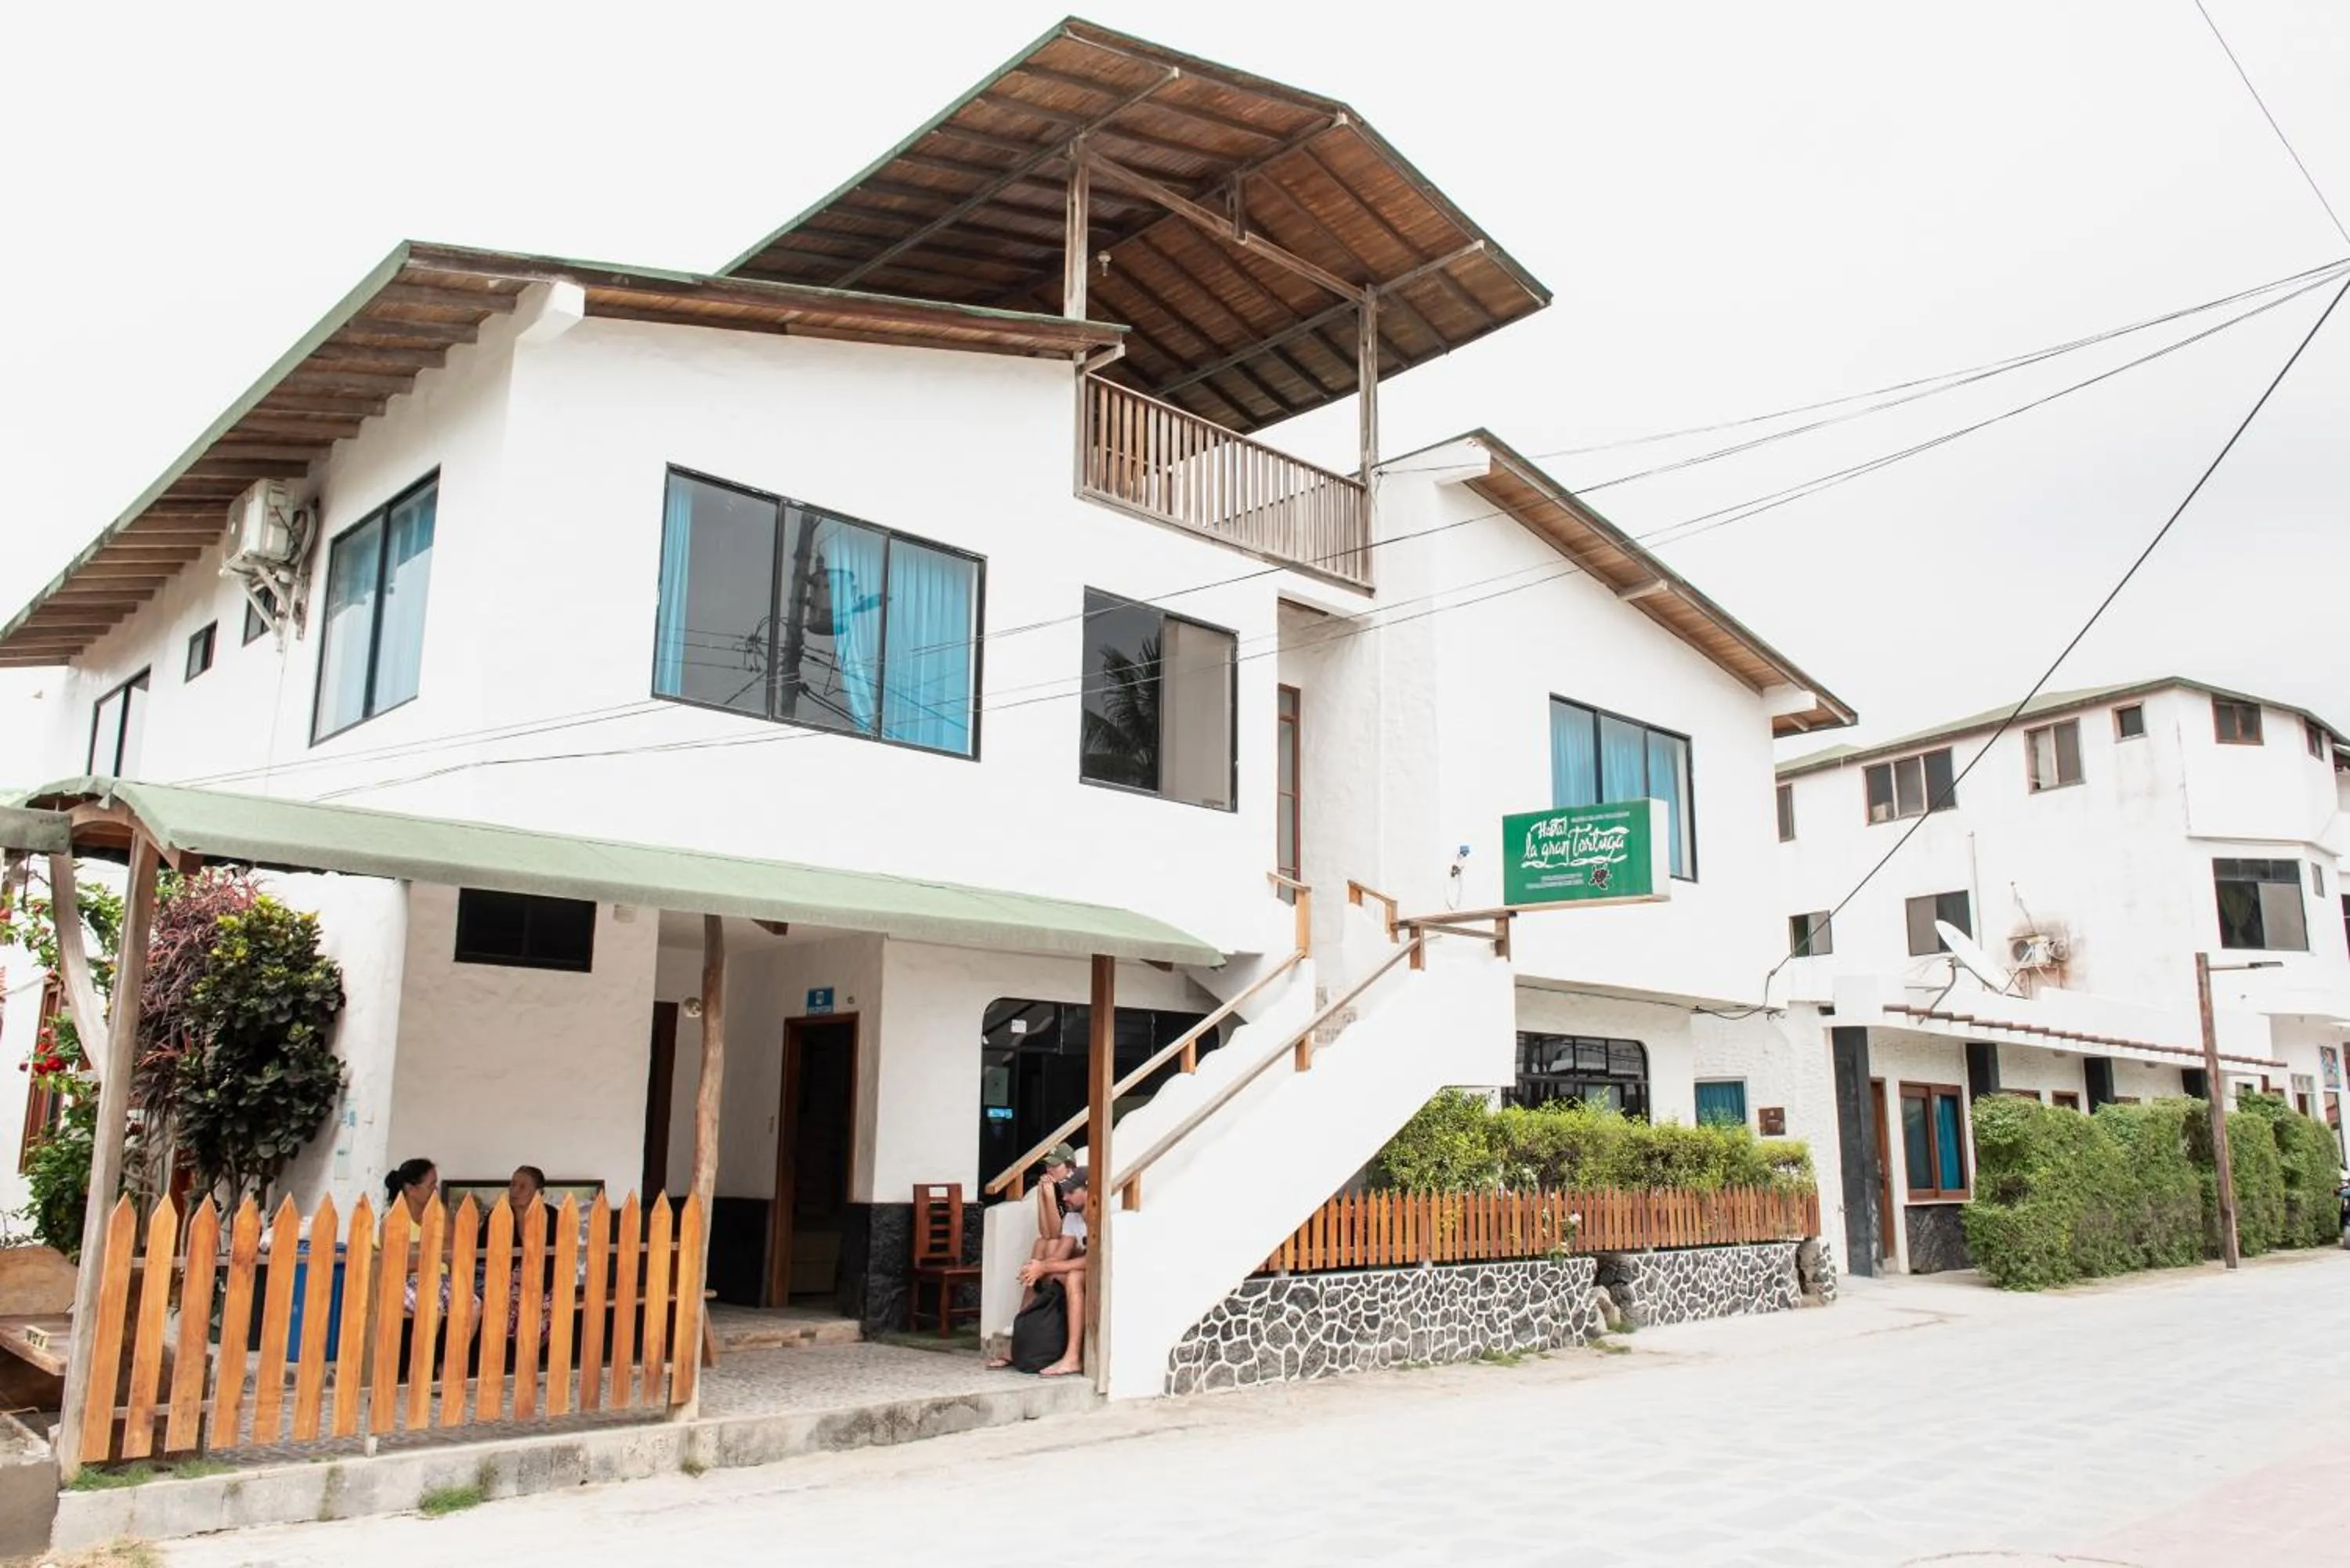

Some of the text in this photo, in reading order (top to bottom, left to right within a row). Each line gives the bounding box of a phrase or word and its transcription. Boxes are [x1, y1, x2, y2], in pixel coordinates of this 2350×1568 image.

[1523, 824, 1629, 864] la gran Tortuga
